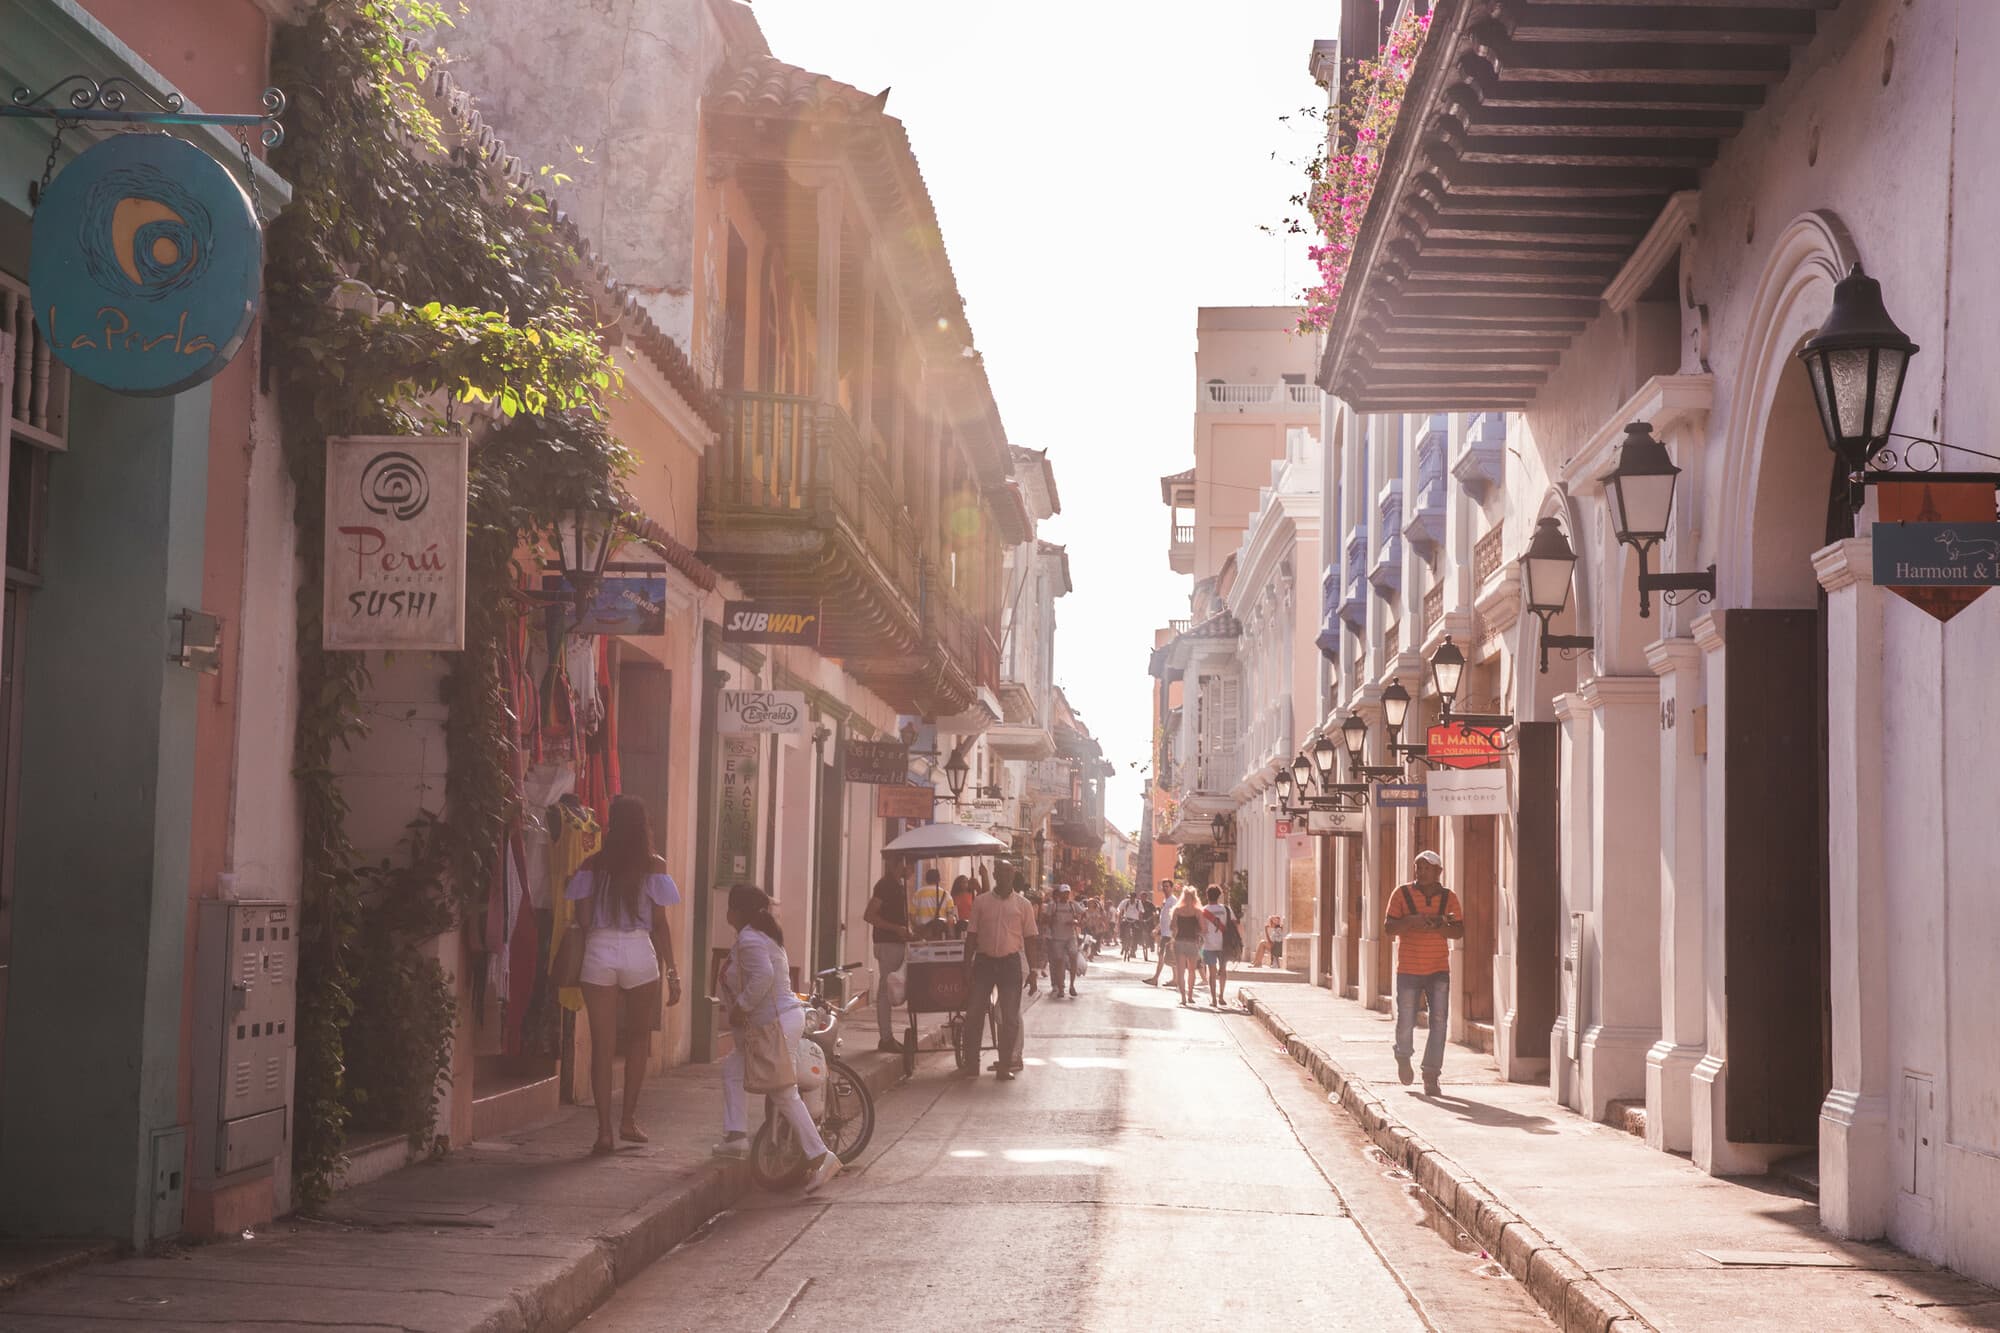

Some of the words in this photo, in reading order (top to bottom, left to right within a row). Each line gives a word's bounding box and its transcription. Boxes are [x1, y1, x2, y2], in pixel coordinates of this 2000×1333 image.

[50, 304, 98, 349] La
[338, 526, 447, 580] Perú
[1896, 562, 1968, 579] Harmont
[1973, 562, 1989, 579] &
[348, 590, 438, 618] SUSHI
[727, 611, 816, 634] SUBWAY
[724, 692, 776, 713] MUZO
[748, 707, 793, 721] Emeralds
[1431, 734, 1444, 745] EL
